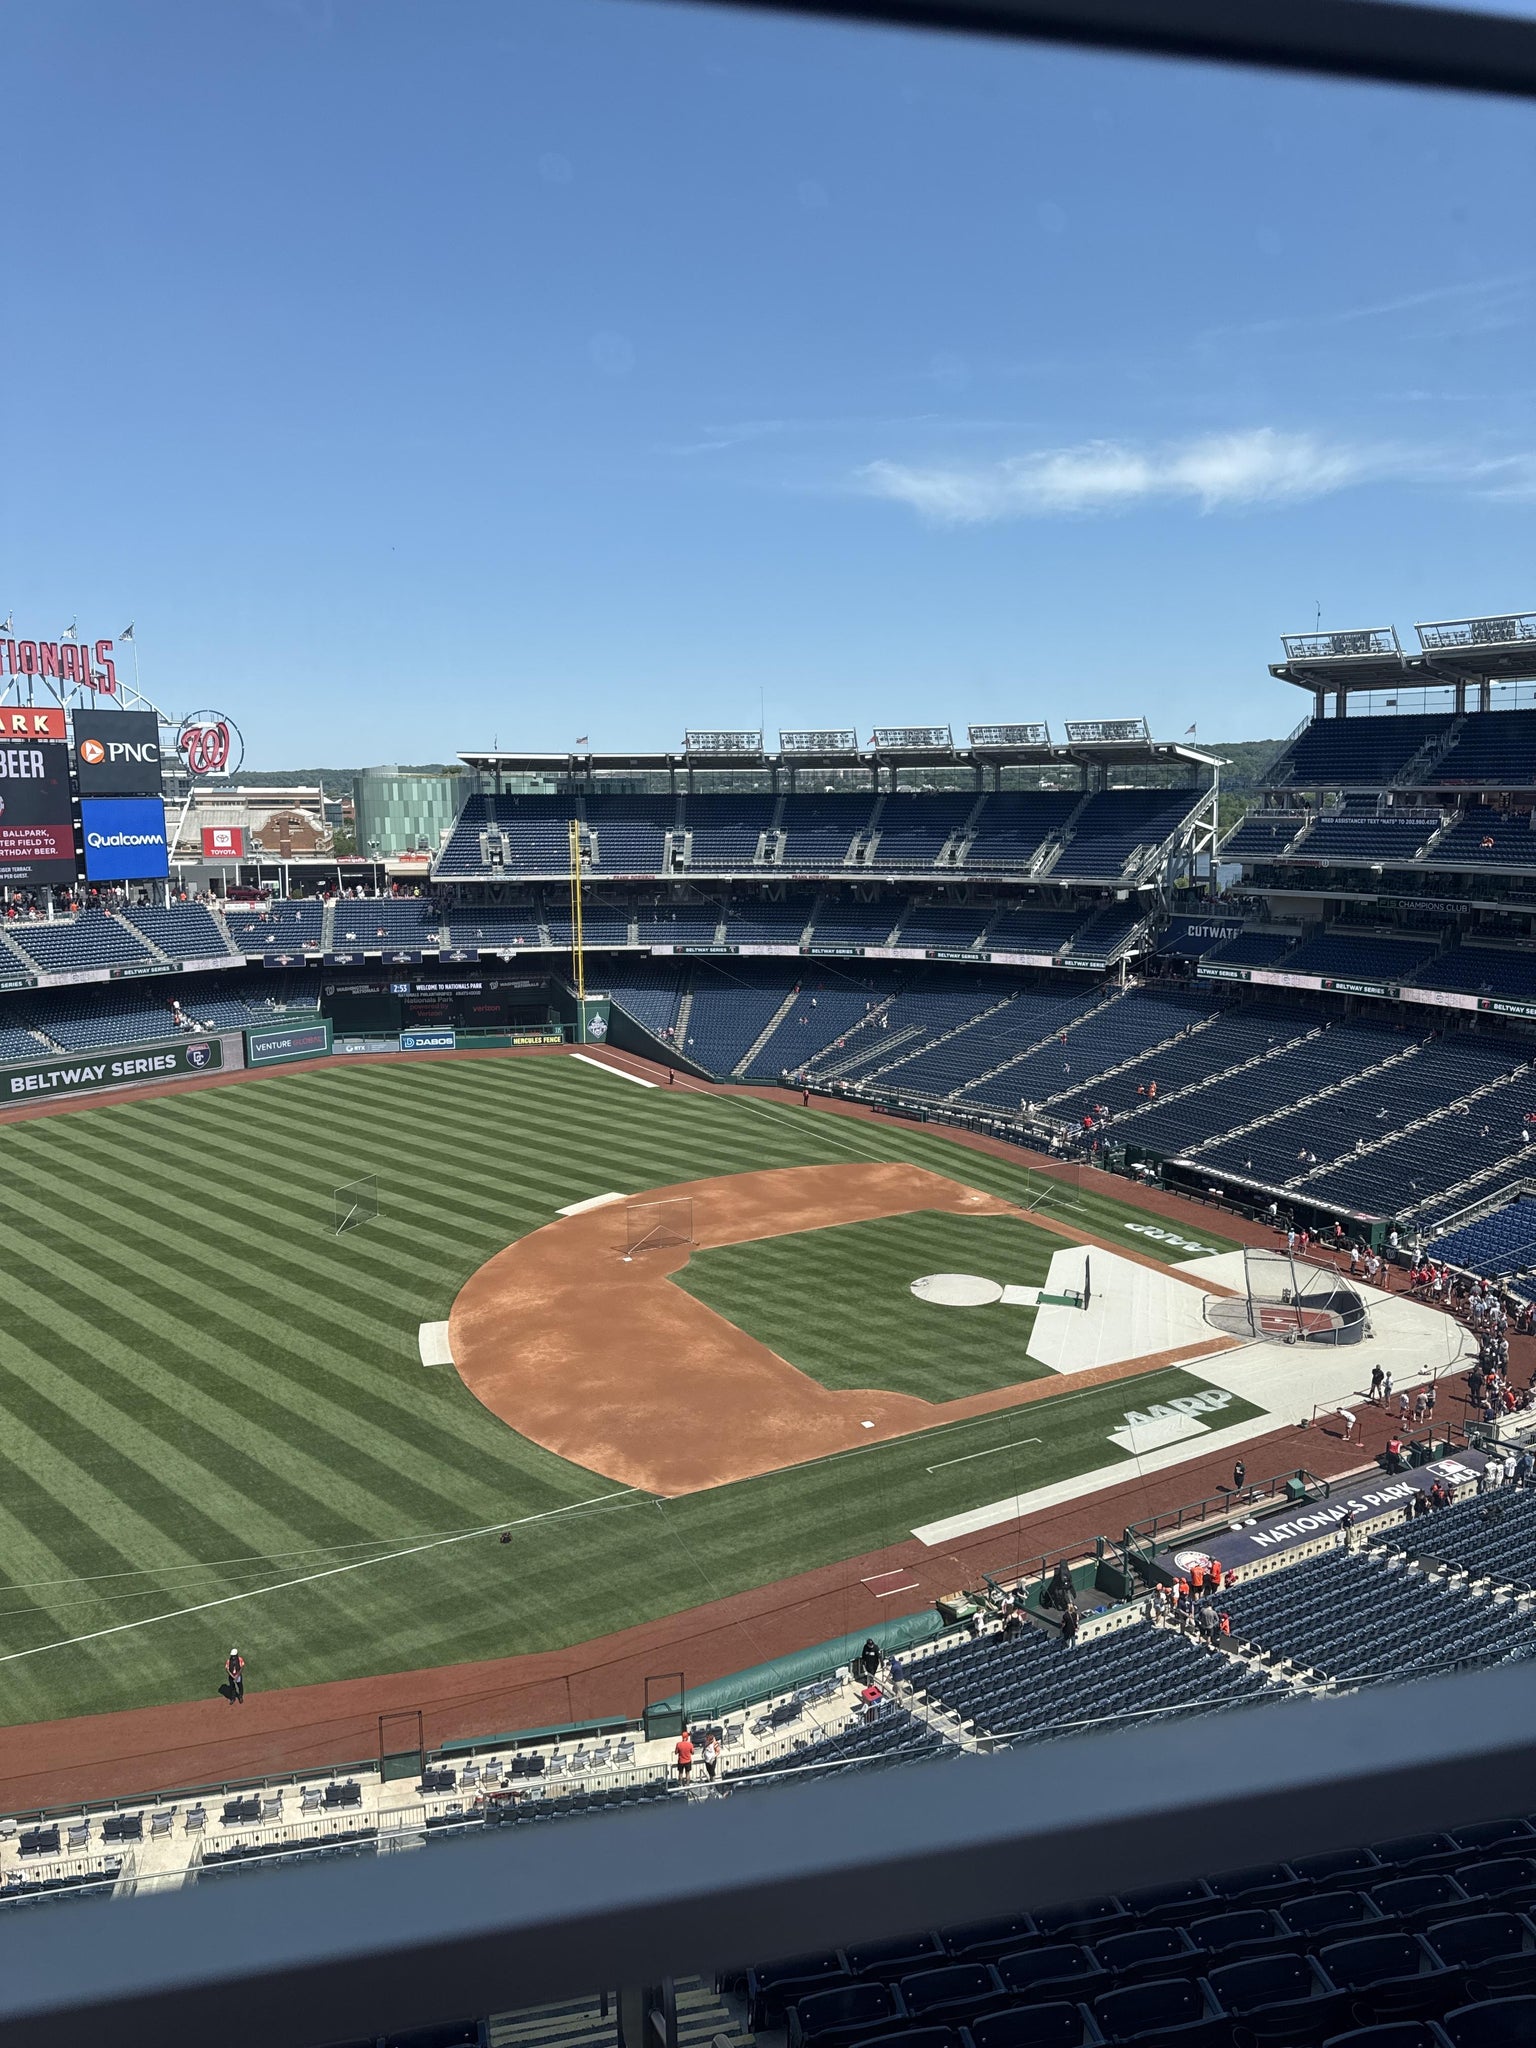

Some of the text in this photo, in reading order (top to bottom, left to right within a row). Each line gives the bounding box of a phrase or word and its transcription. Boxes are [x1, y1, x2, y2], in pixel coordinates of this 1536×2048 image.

[106, 742, 158, 763] PNC
[2, 829, 50, 838] BALLPARK,
[87, 831, 164, 849] Qualcomm
[17, 839, 43, 847] FIELD
[44, 838, 56, 846] TO
[34, 847, 59, 855] BEER.
[1398, 900, 1444, 911] CHAMPIONS
[1445, 904, 1468, 912] CLUB
[1188, 925, 1242, 939] CUTWATE
[394, 984, 408, 992] 2:53
[1336, 983, 1385, 995] BELTWAY SERIES
[1494, 1004, 1524, 1013] BELTWAY
[255, 1035, 322, 1052] VENTURE GLOBAL
[416, 1038, 453, 1046] DABOS
[513, 1037, 542, 1045] HERCULES
[10, 1064, 106, 1093] BELTWAY
[111, 1054, 177, 1077] SERIES
[1194, 1165, 1264, 1188] NATIONALS
[1113, 1389, 1232, 1431] AARP
[1445, 1468, 1481, 1485] MLB
[1250, 1481, 1421, 1547] NATIONALS PARK
